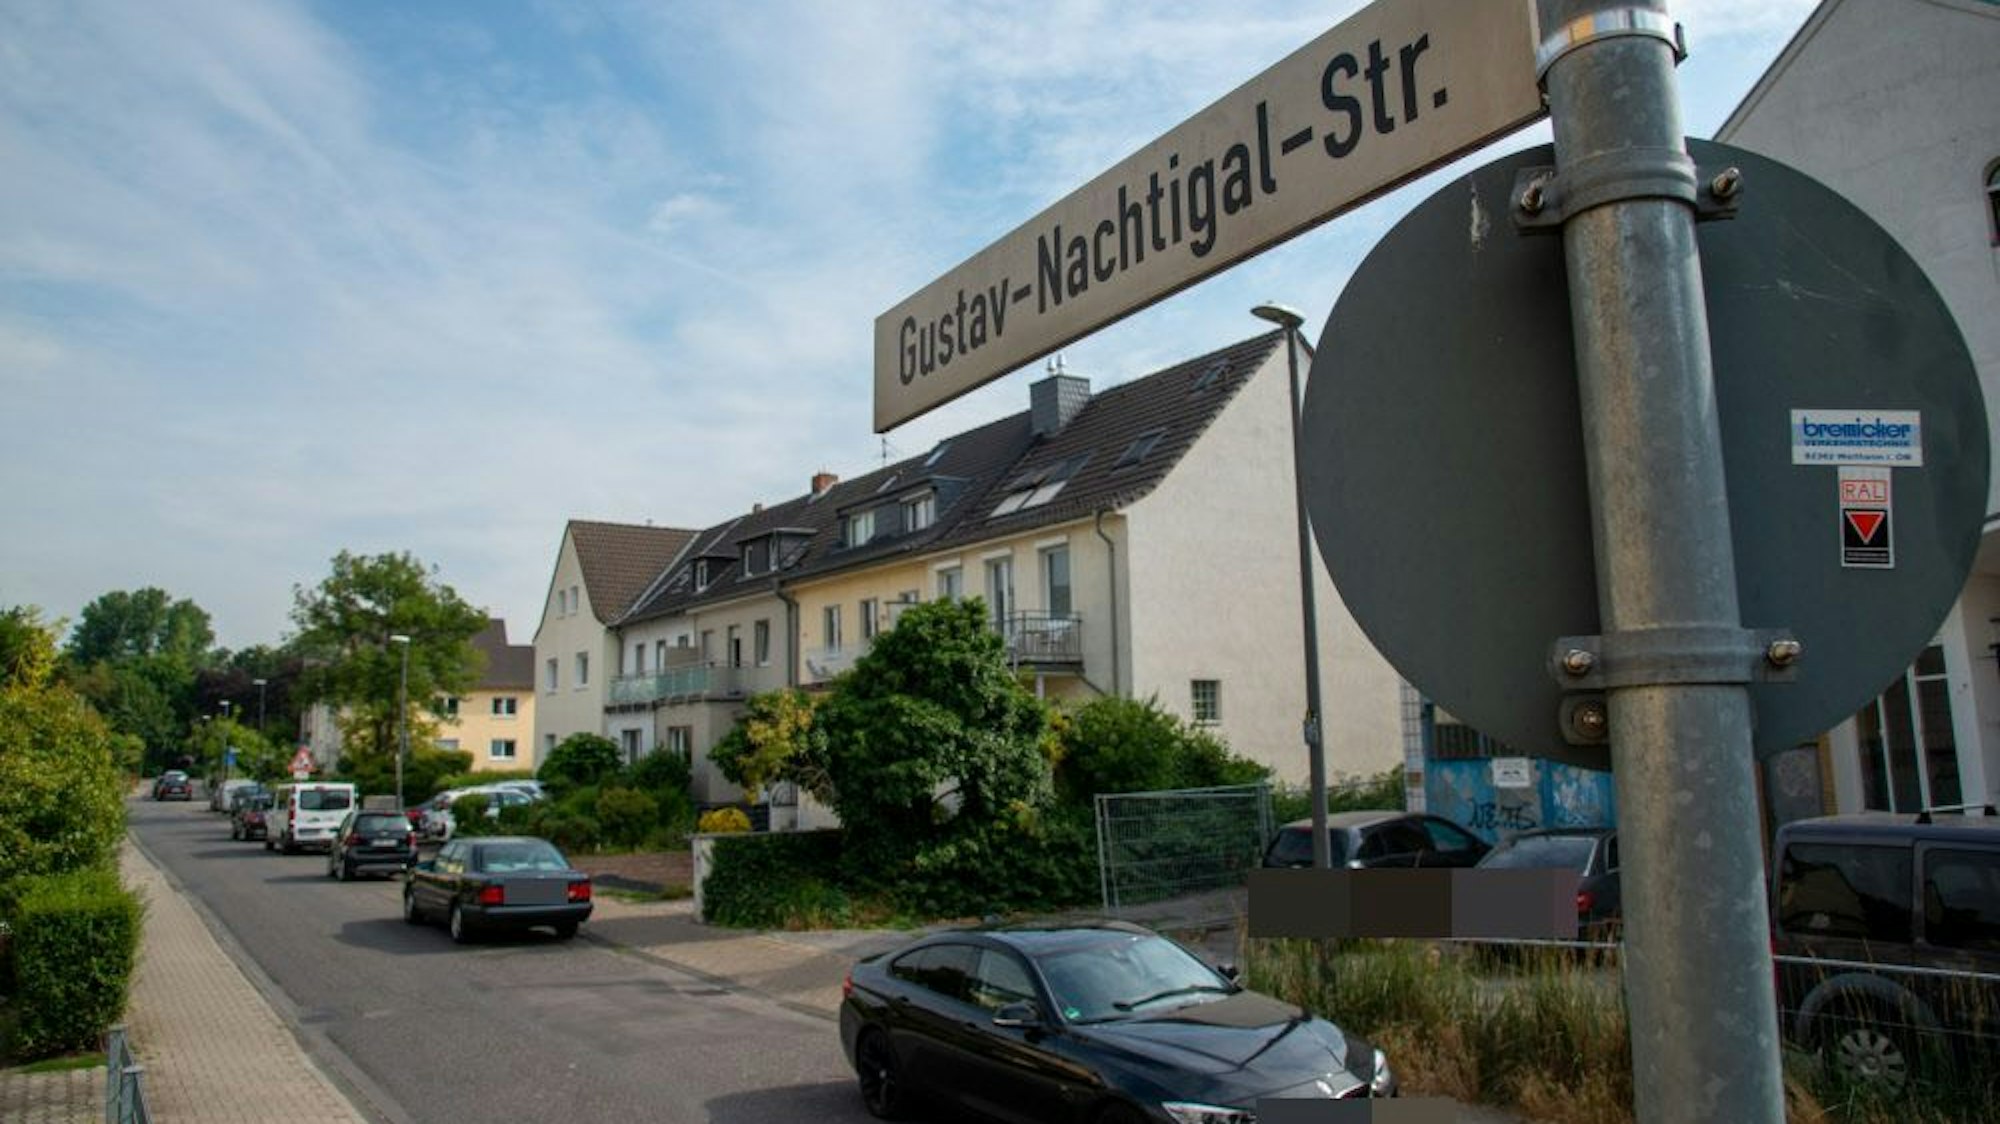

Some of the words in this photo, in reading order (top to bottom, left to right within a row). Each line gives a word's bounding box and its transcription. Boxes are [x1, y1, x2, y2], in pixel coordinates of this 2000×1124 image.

[899, 32, 1449, 386] Gustav-Nachtigal-Str.
[1803, 416, 1911, 438] bremicker
[1845, 483, 1884, 499] RAL
